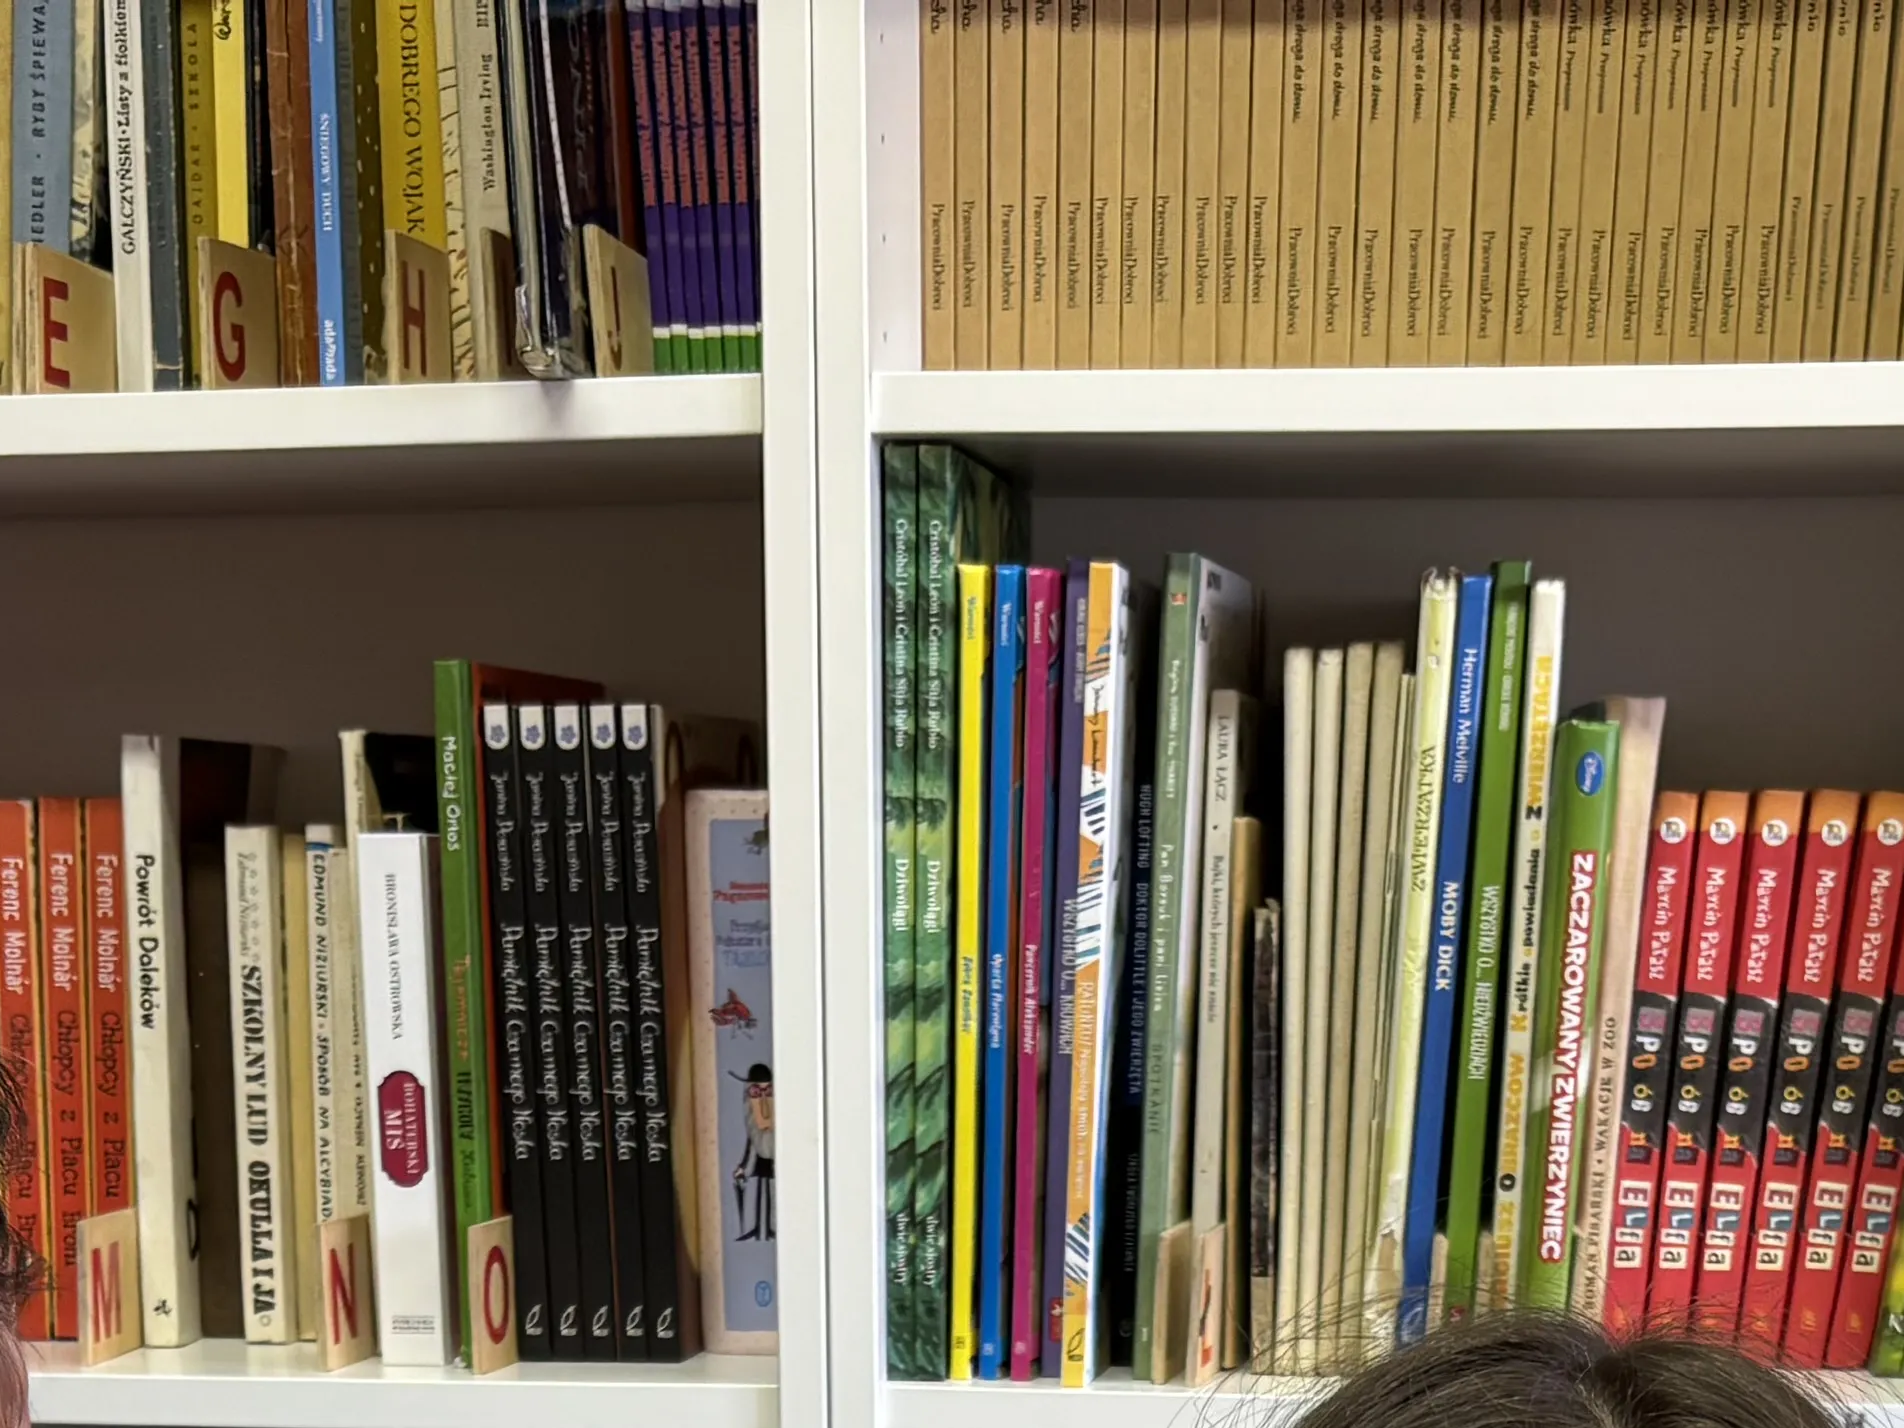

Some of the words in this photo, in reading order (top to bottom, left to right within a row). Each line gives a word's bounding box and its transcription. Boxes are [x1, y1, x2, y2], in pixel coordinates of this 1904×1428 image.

[115, 86, 134, 127] Listy
[399, 3, 422, 138] DOBREGO
[477, 53, 494, 99] Irving
[31, 89, 46, 138] RYBY
[480, 104, 496, 193] Washington
[403, 147, 426, 235] WOJAK
[43, 276, 71, 388] E
[213, 271, 246, 382] G
[401, 261, 427, 377] H
[1455, 648, 1479, 713] Herman
[443, 736, 458, 801] Maciej
[1451, 716, 1474, 784] Melville
[50, 853, 73, 920] Ferenc
[96, 853, 119, 921] Ferenc
[135, 853, 156, 929] Powrót
[312, 853, 328, 926] EDMUND
[1438, 880, 1460, 941] MOBY
[1654, 867, 1679, 926] Marcin
[53, 928, 77, 992] Molnár
[97, 928, 118, 993] Molnár
[138, 937, 160, 1030] Daleków
[314, 932, 329, 1019] NIZIURSKI
[1434, 944, 1457, 991] DICK
[1553, 852, 1595, 1075] ZACZAROWANY
[96, 1010, 123, 1097] Chłopcy
[240, 964, 270, 1098] SZKOLNY
[315, 1034, 331, 1098] SPOSÓB
[1602, 1017, 1617, 1047] ZOO
[245, 1100, 270, 1146] LUD
[318, 1107, 330, 1133] NA
[403, 1081, 421, 1177] BOHATERSKI
[1592, 1080, 1614, 1152] WAKACJE
[104, 1137, 126, 1197] Placu
[1539, 1077, 1579, 1263] ZWIERZYNIEC
[247, 1161, 273, 1263] OKULLA
[91, 1241, 122, 1343] M
[328, 1242, 360, 1346] N
[483, 1245, 510, 1344] O
